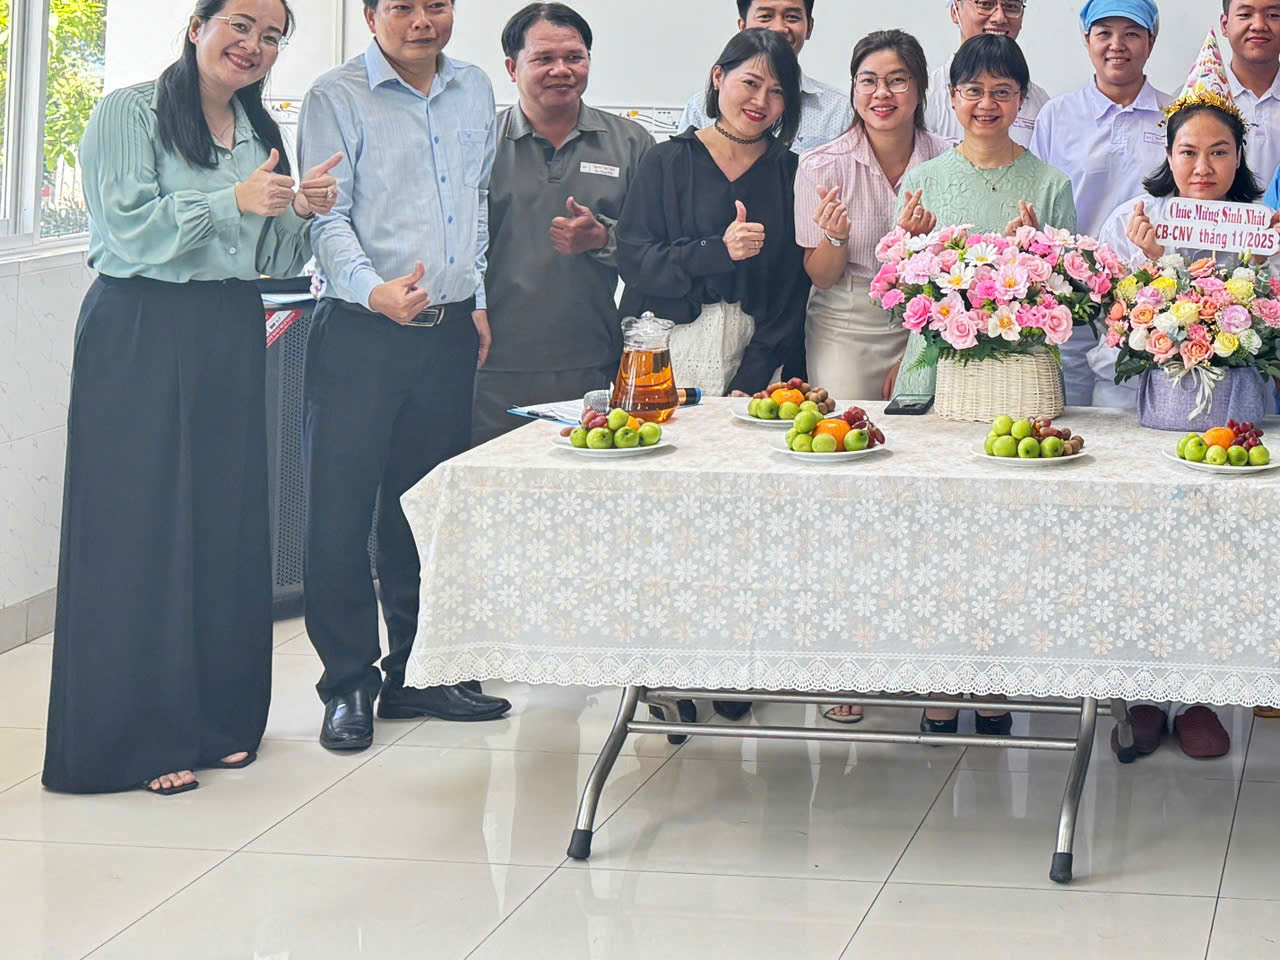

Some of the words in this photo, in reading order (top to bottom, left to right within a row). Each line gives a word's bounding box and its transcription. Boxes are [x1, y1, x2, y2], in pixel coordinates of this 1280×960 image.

[1221, 206, 1243, 224] Sinh
[1155, 223, 1194, 242] CB-CNV
[1199, 226, 1227, 249] tháng
[1232, 230, 1275, 250] 11/2025
